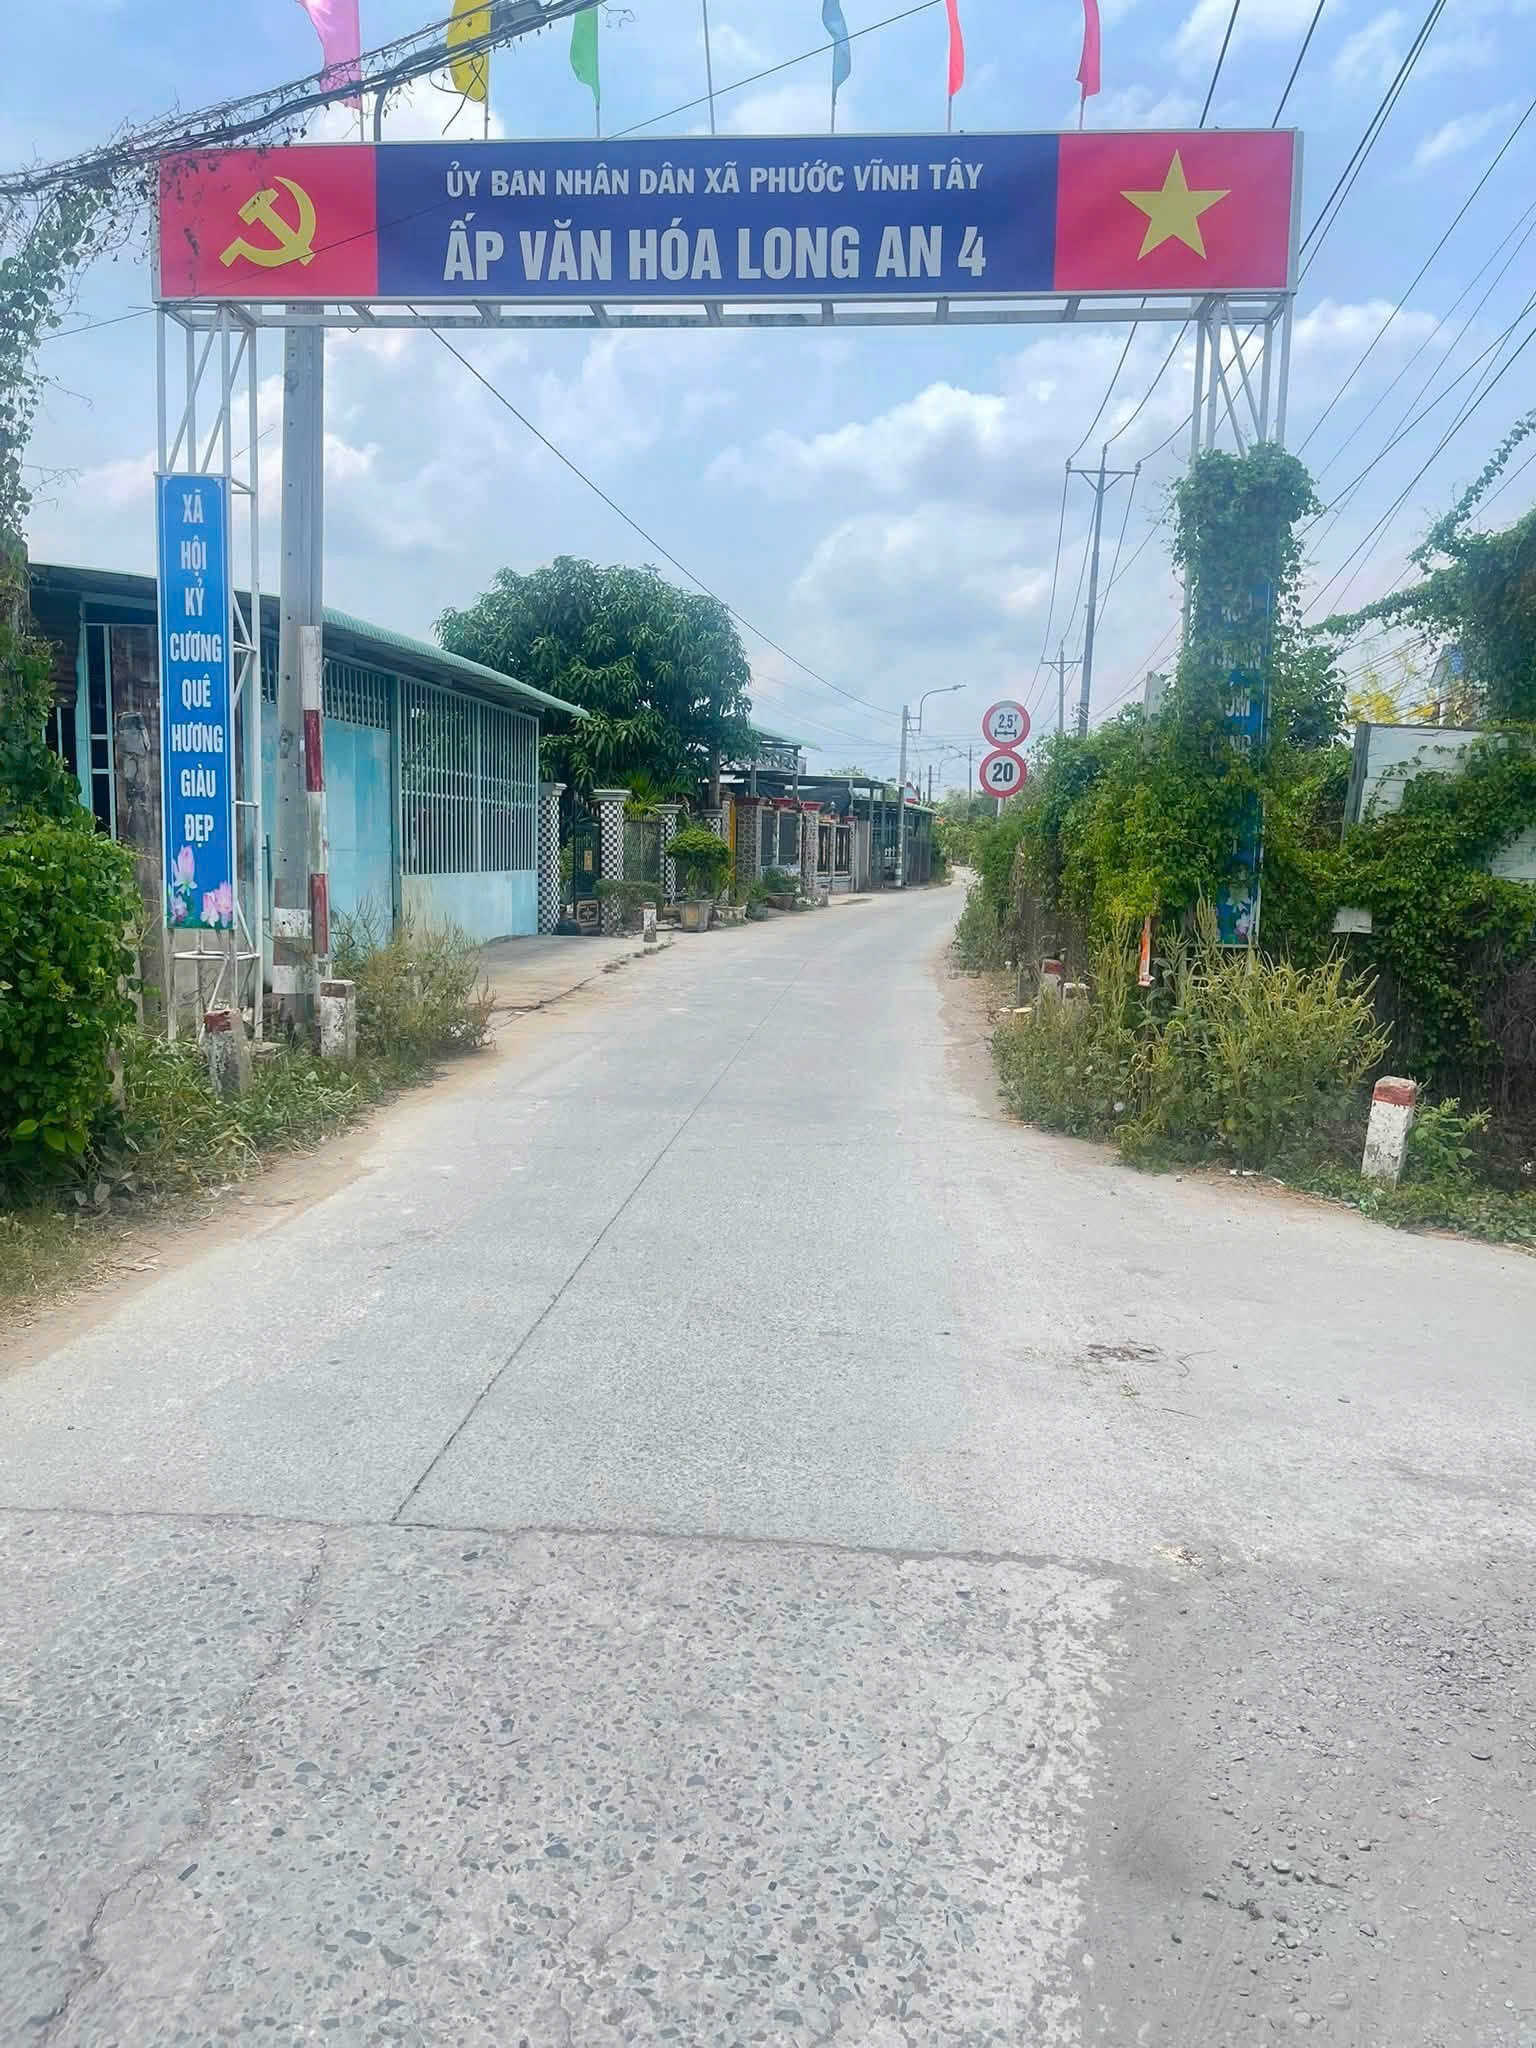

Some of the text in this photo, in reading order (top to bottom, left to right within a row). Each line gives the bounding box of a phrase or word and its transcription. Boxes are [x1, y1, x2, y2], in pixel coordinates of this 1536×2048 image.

[446, 157, 984, 198] ỦY BAN NHÂN DÂN XÃ PHƯỚC VĨNH TÂY
[443, 212, 987, 282] ẤP VĂN HÓA LONG AN 4
[182, 488, 204, 524] XÃ
[180, 535, 207, 577] HỘI
[184, 577, 205, 617] KỶ
[169, 630, 222, 663] CƯƠNG
[181, 673, 212, 710] QUÊ
[171, 721, 224, 753] HƯƠNG
[180, 763, 217, 799] GIÀU
[991, 762, 1014, 782] 20
[184, 813, 215, 848] ĐẸP
